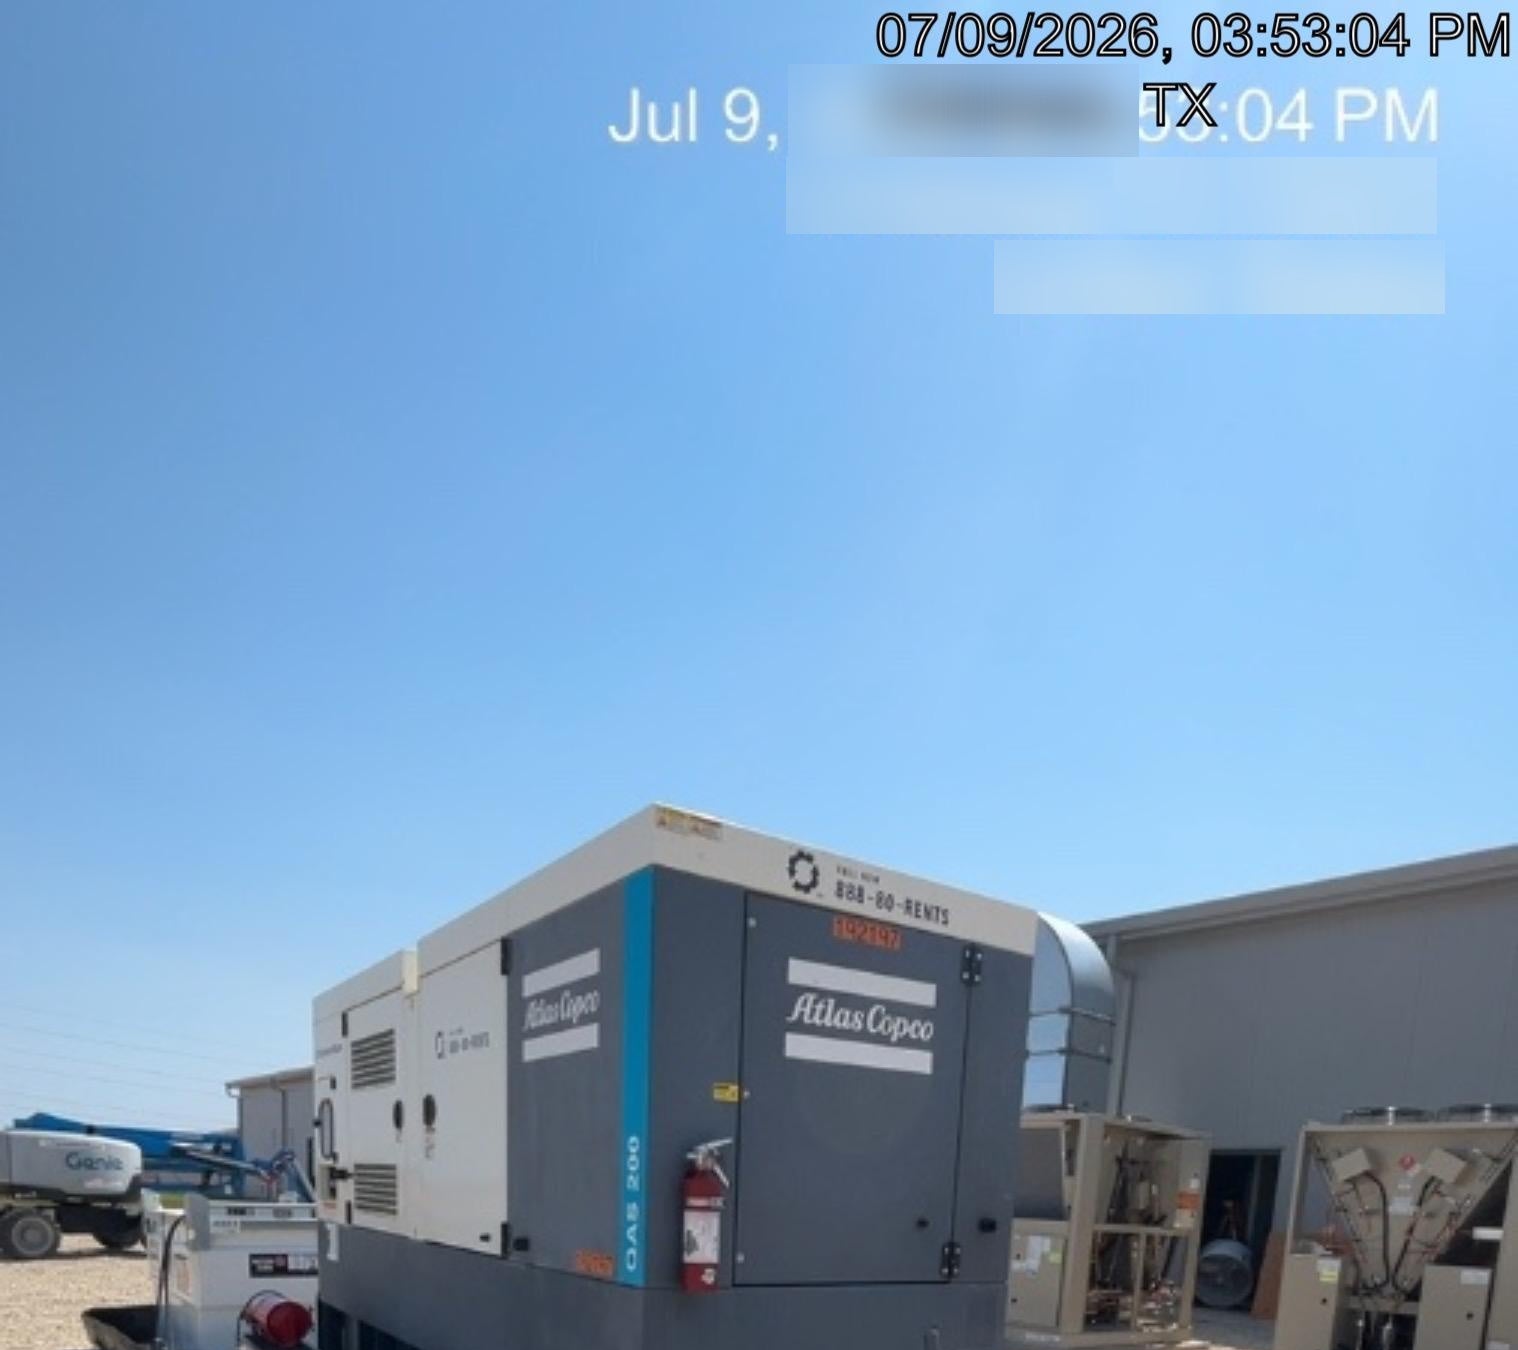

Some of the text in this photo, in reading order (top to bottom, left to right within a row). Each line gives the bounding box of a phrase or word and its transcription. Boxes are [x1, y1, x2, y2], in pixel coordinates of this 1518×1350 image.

[786, 992, 934, 1042] Atlas Copco
[625, 1135, 640, 1191] 200
